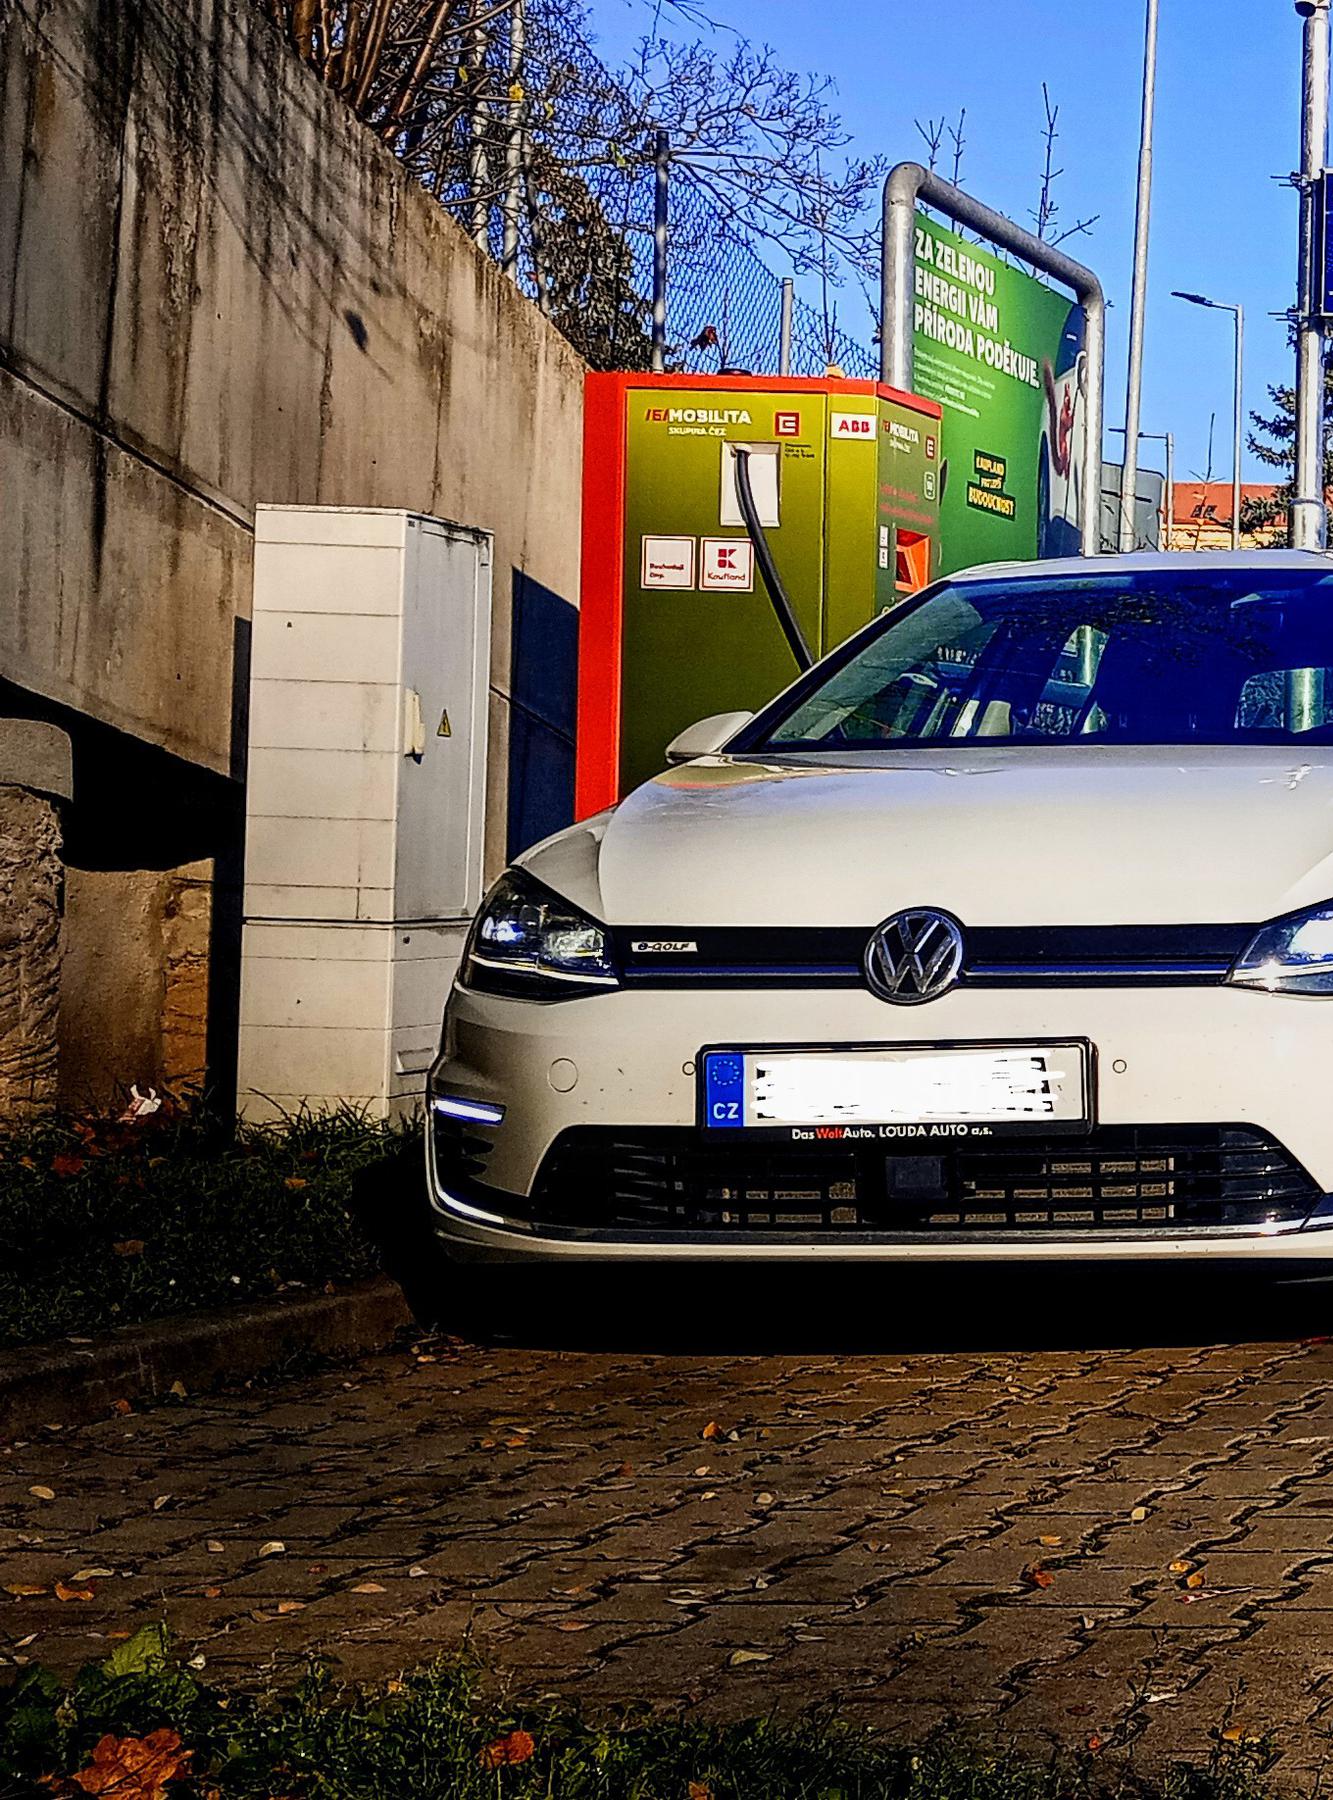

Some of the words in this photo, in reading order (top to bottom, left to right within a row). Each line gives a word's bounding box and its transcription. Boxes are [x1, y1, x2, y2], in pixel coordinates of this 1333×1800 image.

[914, 228, 934, 265] ZA
[935, 240, 995, 296] ZELENOU
[914, 266, 967, 319] ENERGII
[968, 292, 998, 334] VÁM
[914, 300, 975, 359] PŘÍRODA
[976, 339, 1041, 389] PODĚKUJE.
[838, 420, 870, 433] ABB
[707, 572, 746, 581] Kaufland
[713, 1102, 739, 1120] CZ
[879, 1125, 926, 1138] LOUDA
[929, 1124, 969, 1138] AUTO
